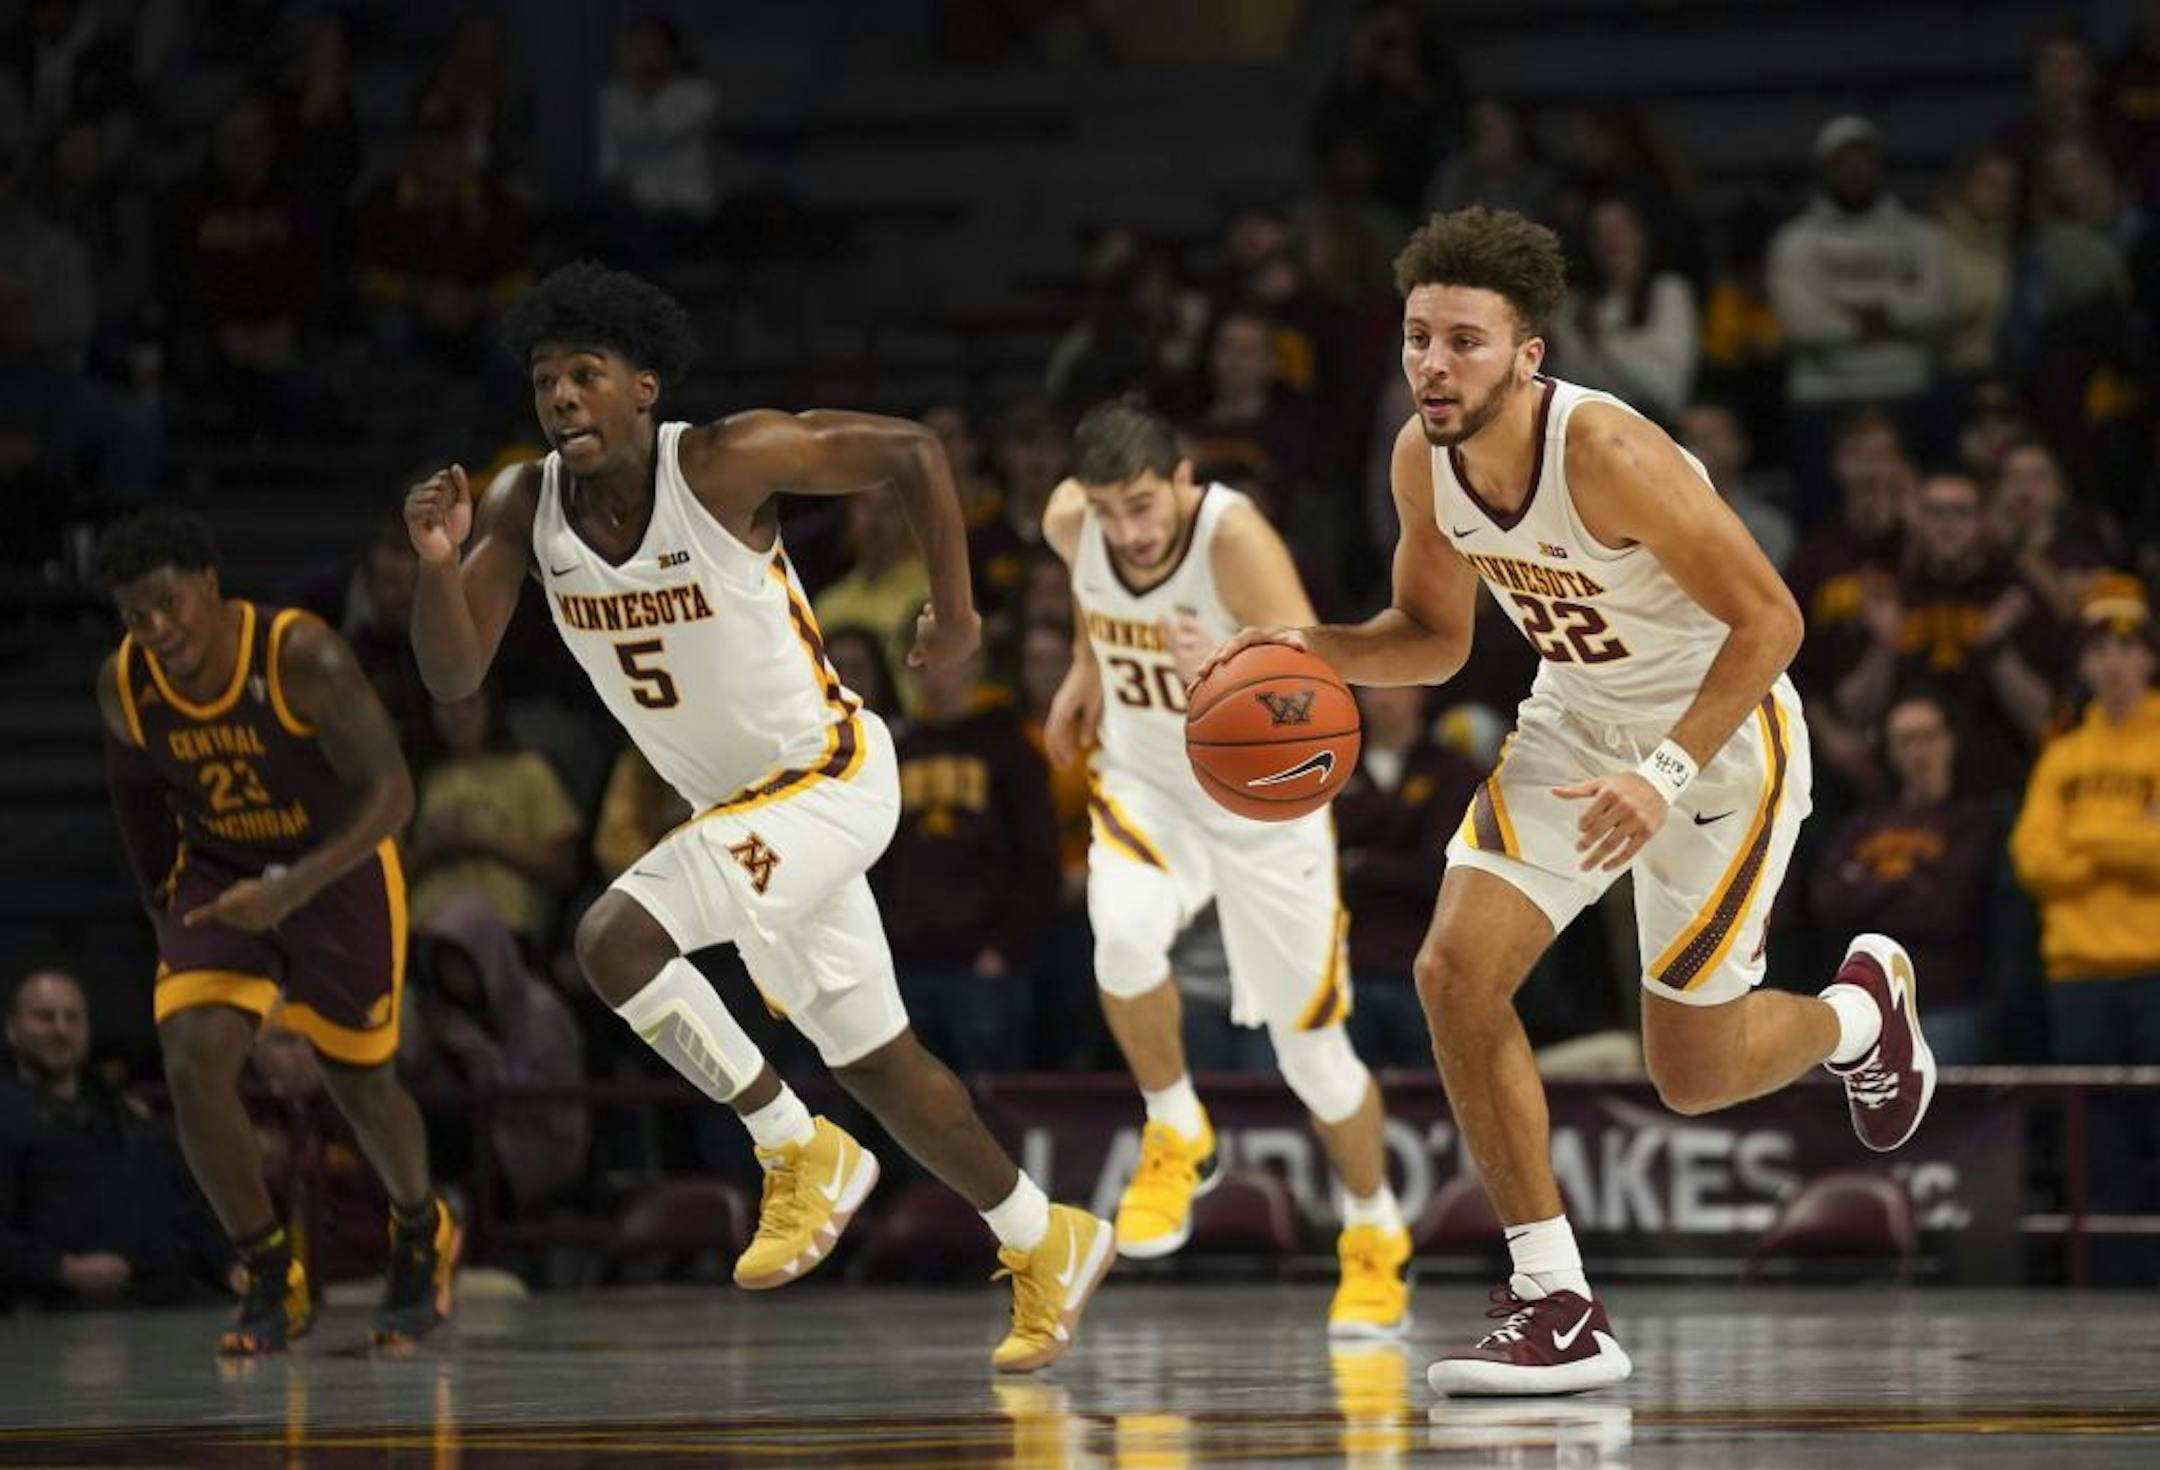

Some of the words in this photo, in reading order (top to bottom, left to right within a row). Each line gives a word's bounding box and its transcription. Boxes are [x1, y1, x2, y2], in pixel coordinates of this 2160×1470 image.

[555, 581, 713, 630] MINNESOTA
[1511, 592, 1631, 663] 22
[614, 638, 679, 708] 5
[1108, 656, 1189, 714] 30
[201, 760, 271, 812] 23
